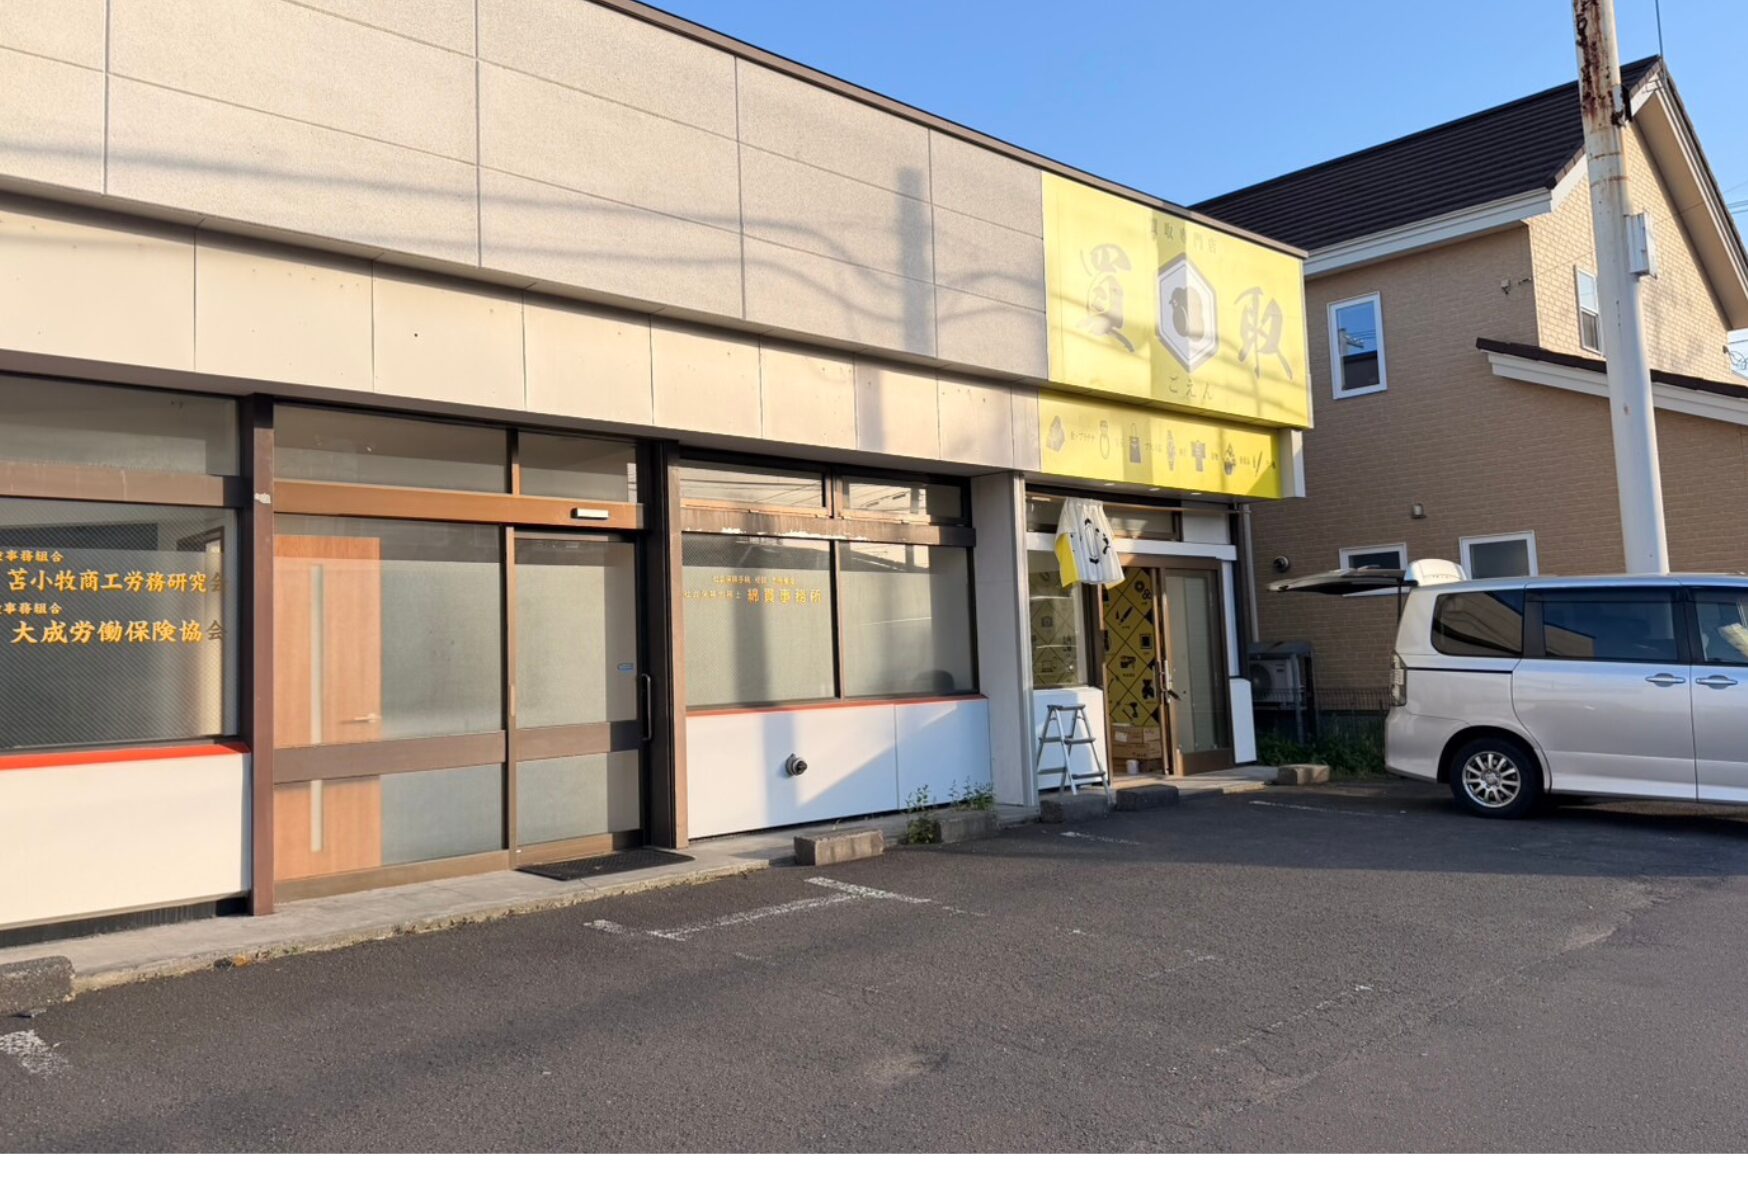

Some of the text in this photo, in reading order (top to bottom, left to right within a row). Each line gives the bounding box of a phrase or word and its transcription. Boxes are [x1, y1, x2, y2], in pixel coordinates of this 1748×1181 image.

[0, 549, 64, 564] 事務組合
[7, 567, 226, 593] 苫小牧商工労務研究会
[0, 601, 63, 616] 事務組合
[11, 619, 227, 644] 大成労働保険協会
